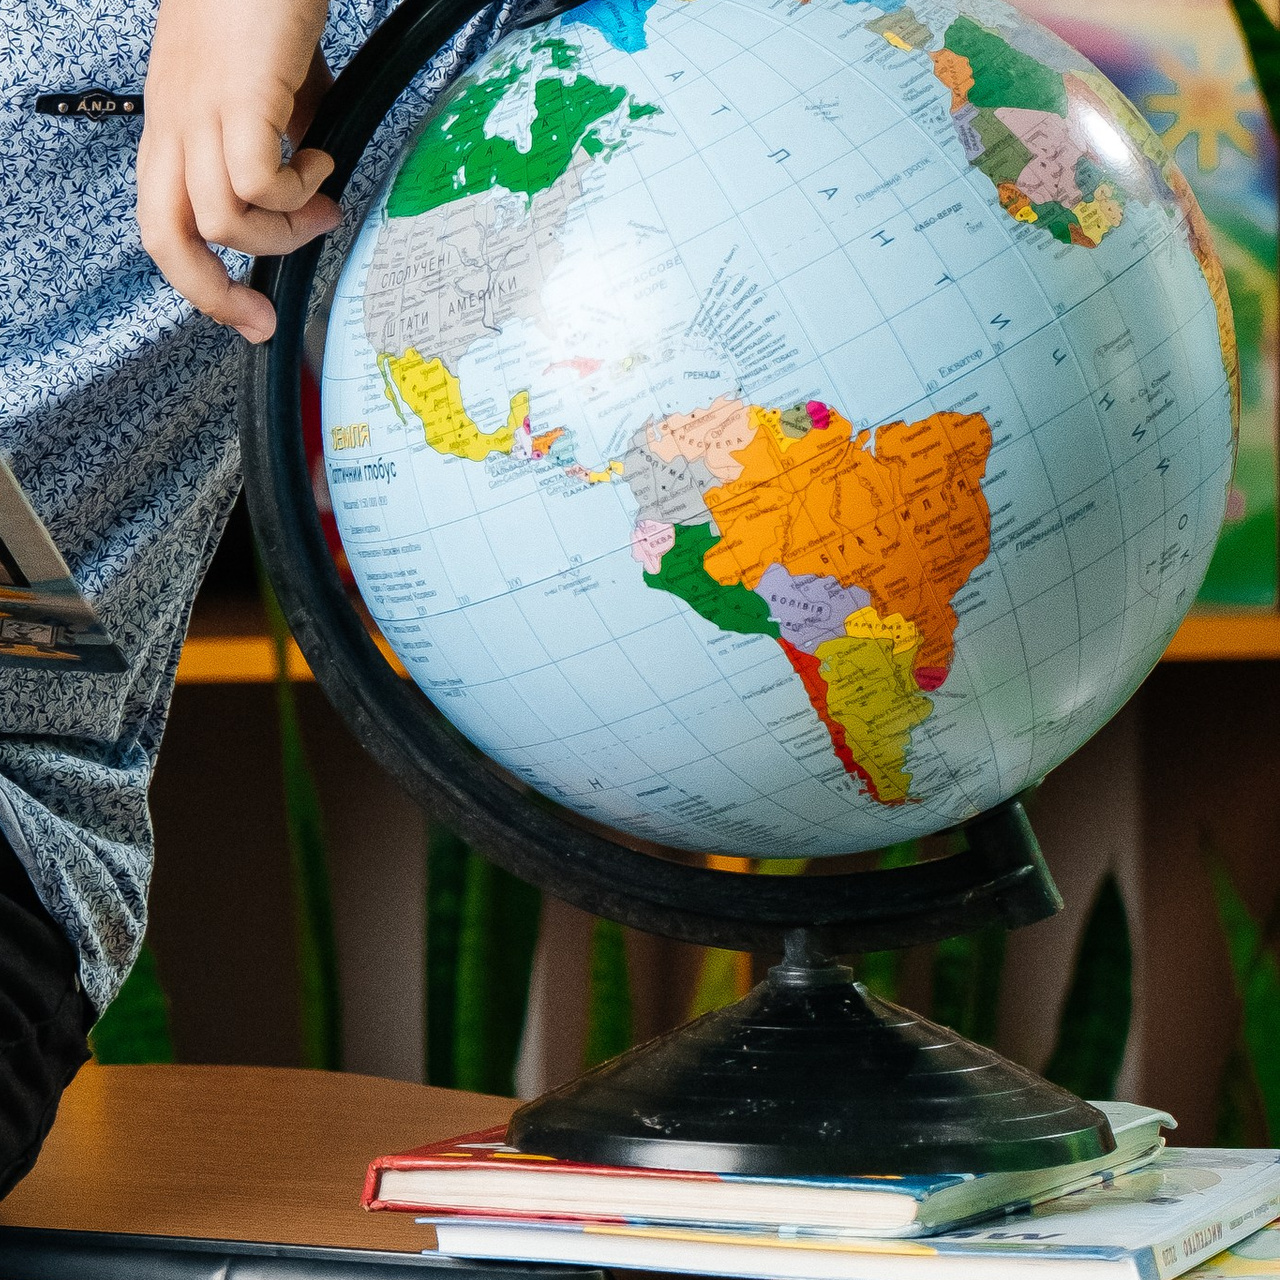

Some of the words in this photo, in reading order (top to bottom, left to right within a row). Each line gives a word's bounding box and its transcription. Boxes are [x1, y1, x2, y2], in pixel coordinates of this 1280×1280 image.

[381, 253, 451, 289] СПОЛУЧЕНІ
[448, 276, 517, 317] АМЕРИКИ
[683, 370, 721, 380] ГРЕНАДА
[938, 349, 984, 378] Екватор
[363, 457, 397, 485] глобус
[771, 594, 824, 613] БОЛІВІЯ
